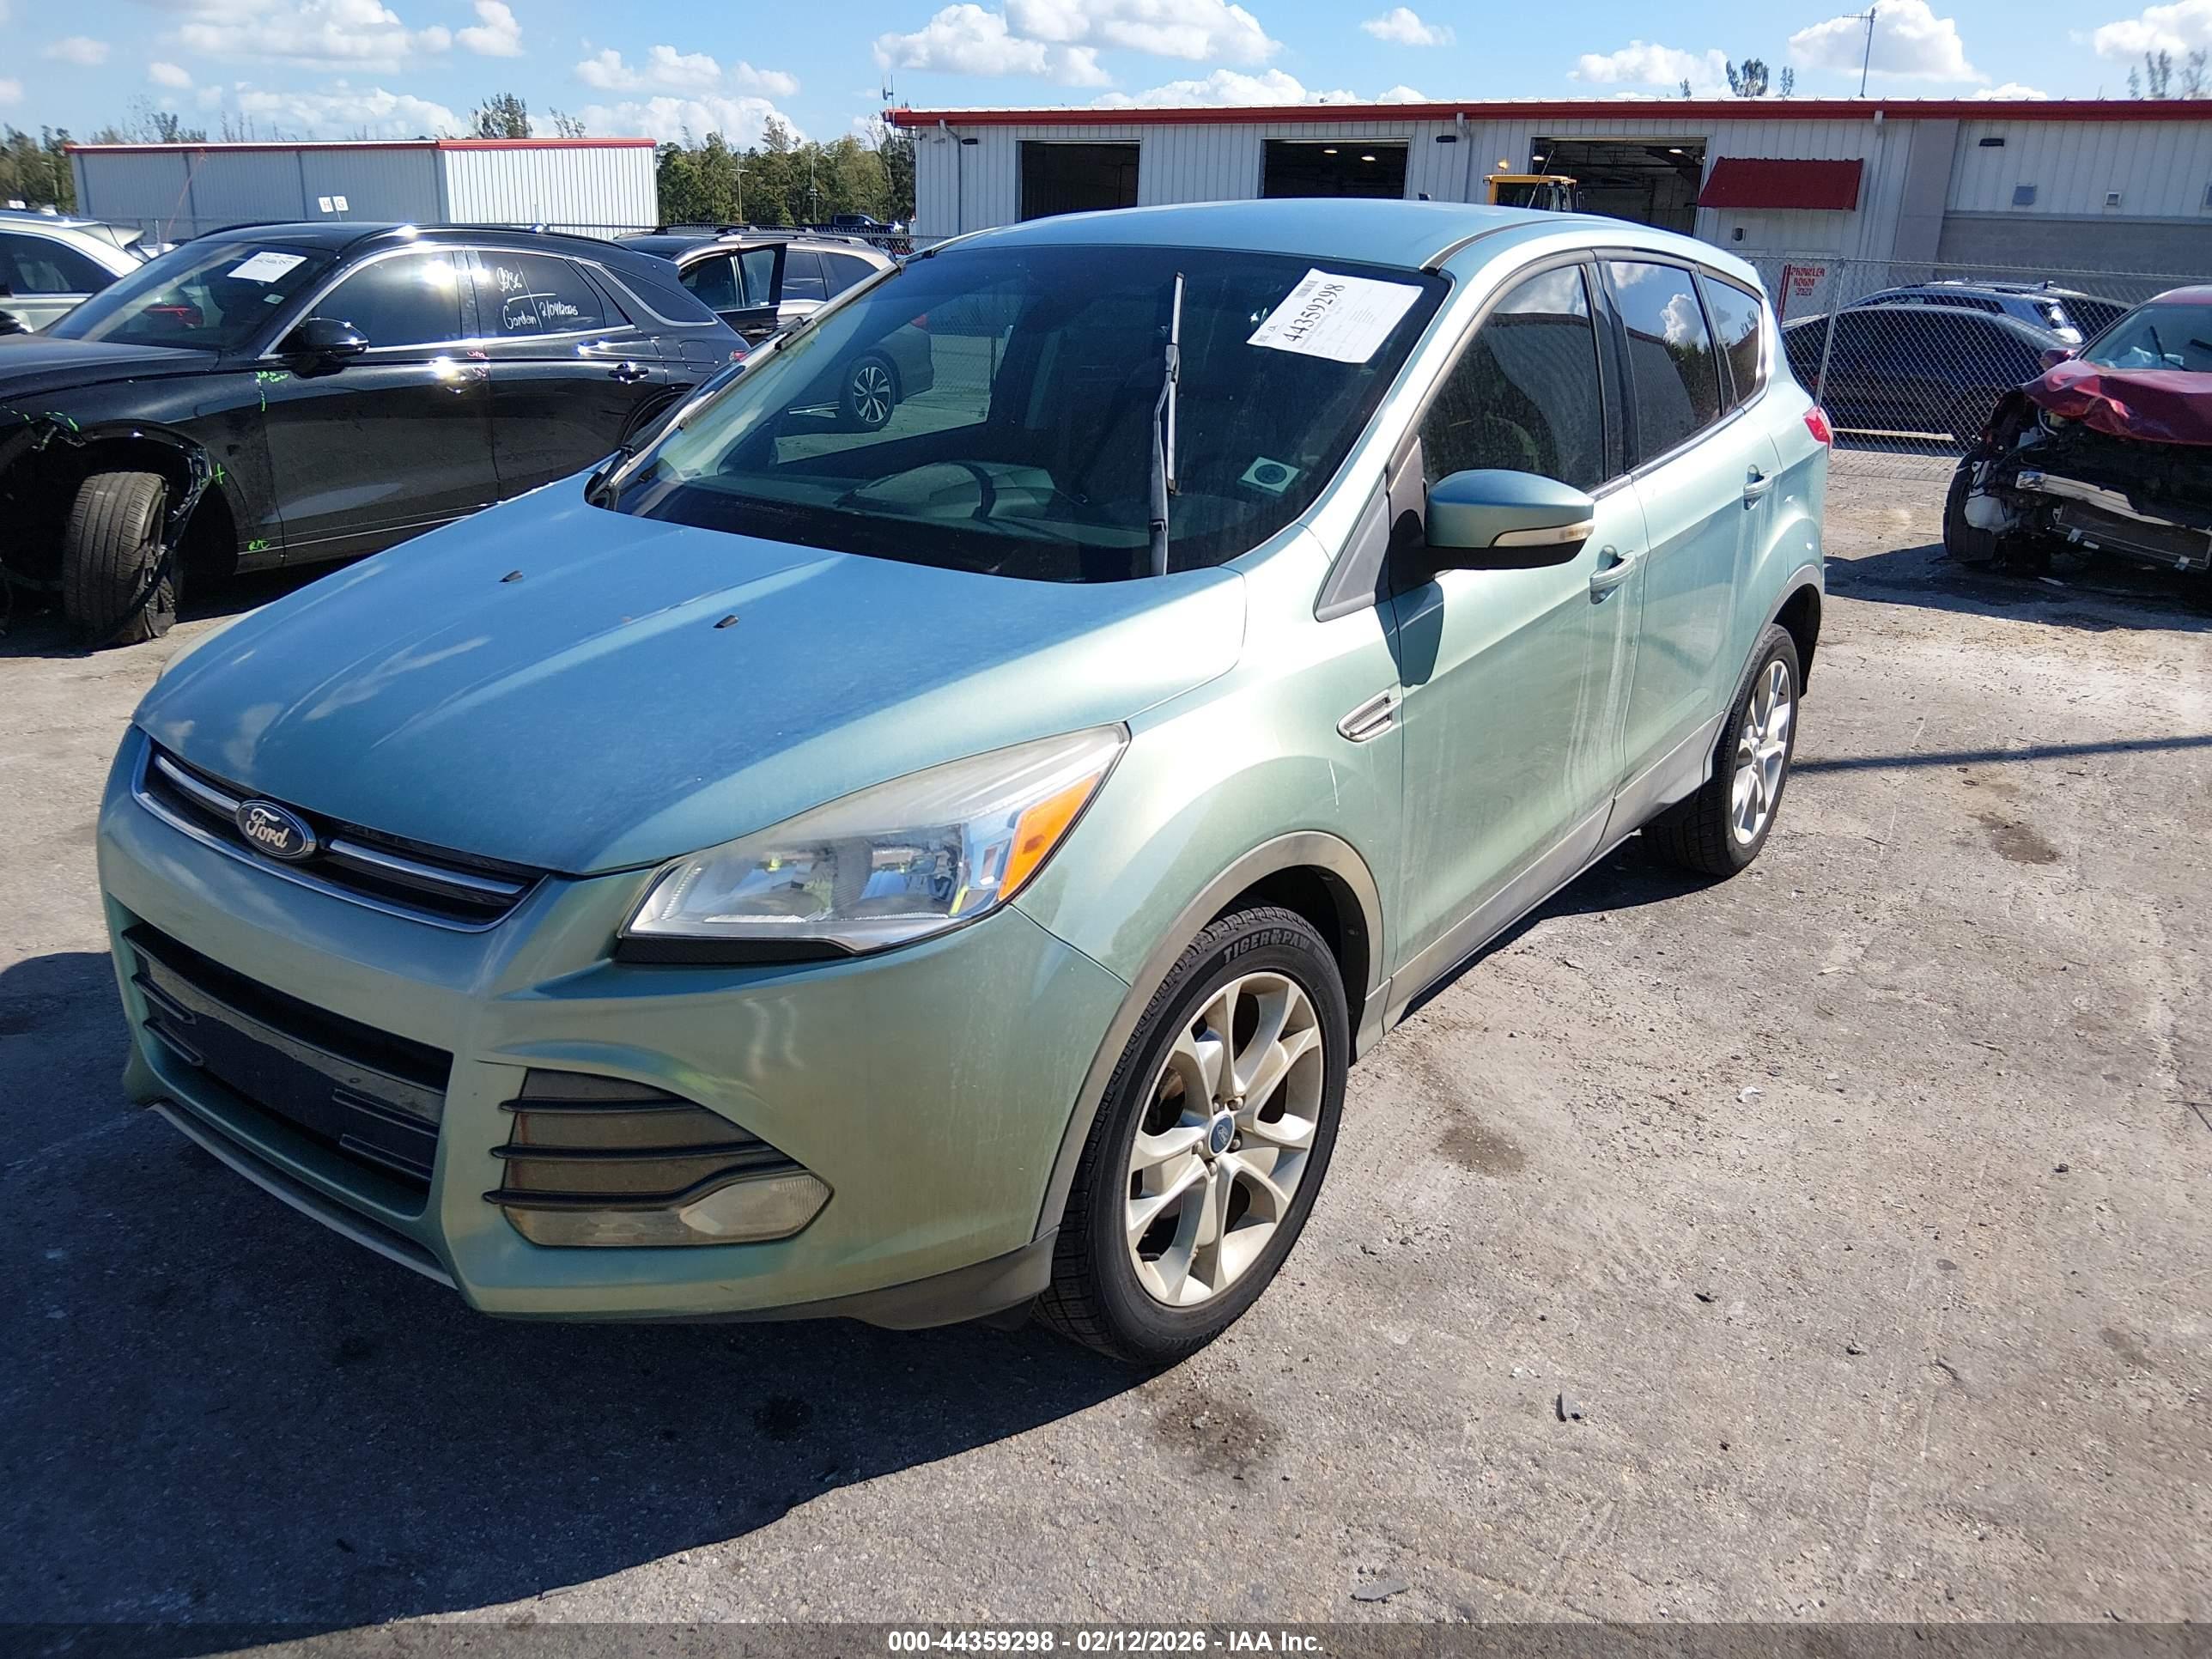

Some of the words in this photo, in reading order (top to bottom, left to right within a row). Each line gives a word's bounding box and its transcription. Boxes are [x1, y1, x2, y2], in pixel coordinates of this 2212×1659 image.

[322, 199, 331, 210] H
[337, 198, 345, 209] G
[1283, 283, 1346, 343] 44359298
[246, 808, 290, 848] Ford
[1223, 931, 1270, 963] TIGER
[1282, 930, 1310, 951] PAW
